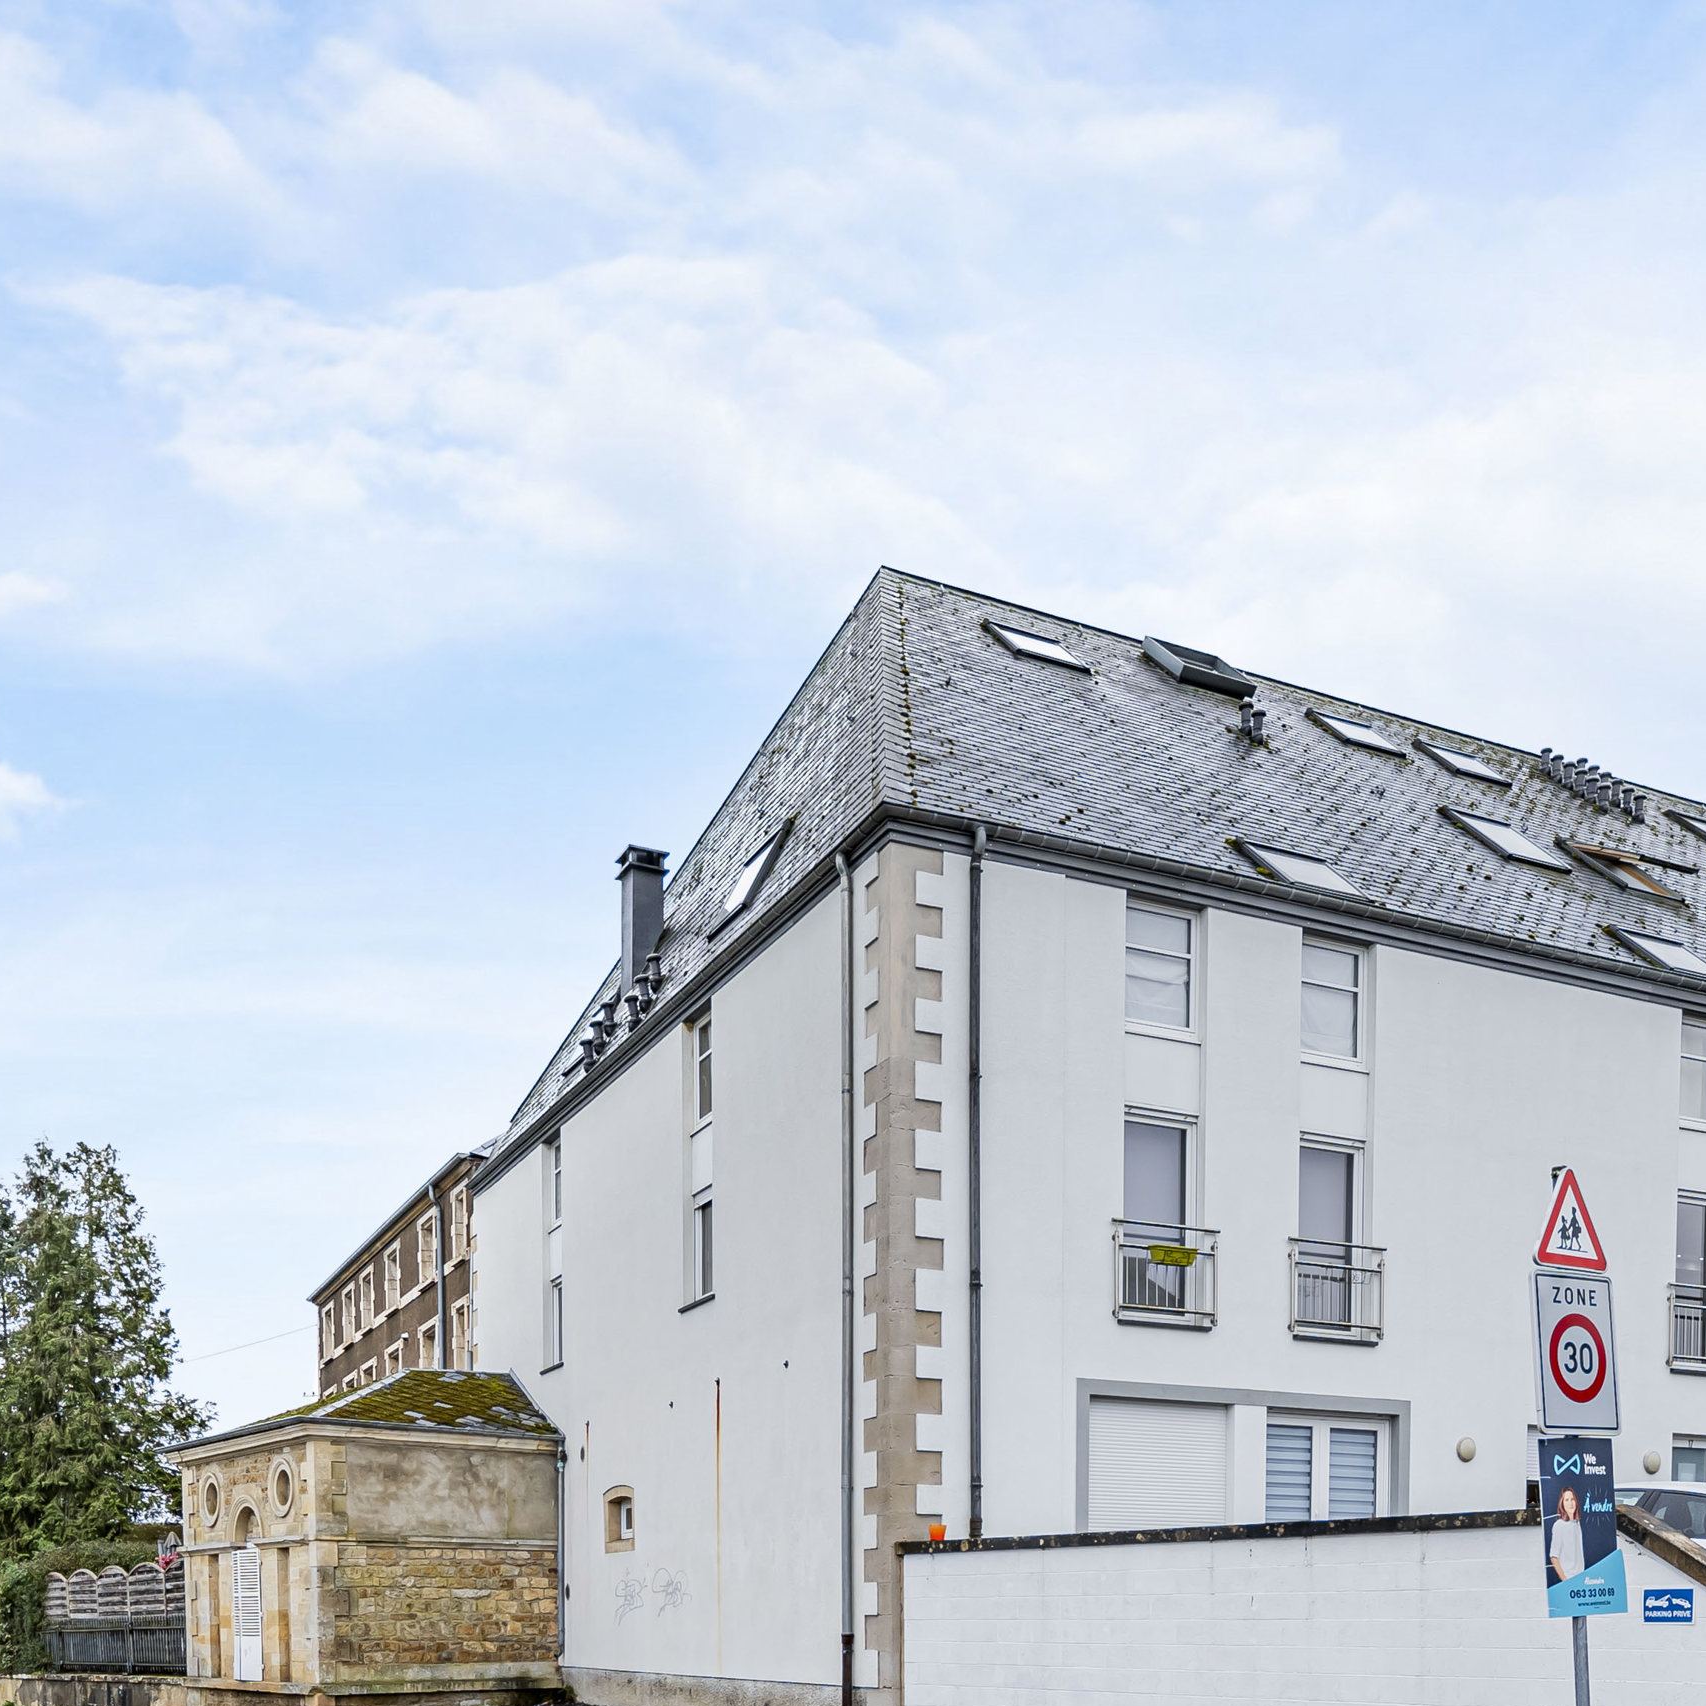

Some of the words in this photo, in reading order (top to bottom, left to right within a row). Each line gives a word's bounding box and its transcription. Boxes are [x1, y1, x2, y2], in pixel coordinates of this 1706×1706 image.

[1552, 1286, 1597, 1306] ZONE
[1564, 1341, 1593, 1374] 30
[1583, 1453, 1597, 1465] We
[1584, 1464, 1606, 1475] Invest
[1591, 1498, 1613, 1512] vendre
[1569, 1588, 1587, 1599] 063
[1588, 1588, 1597, 1598] 33
[1598, 1587, 1607, 1597] 00
[1645, 1610, 1672, 1618] PARKING
